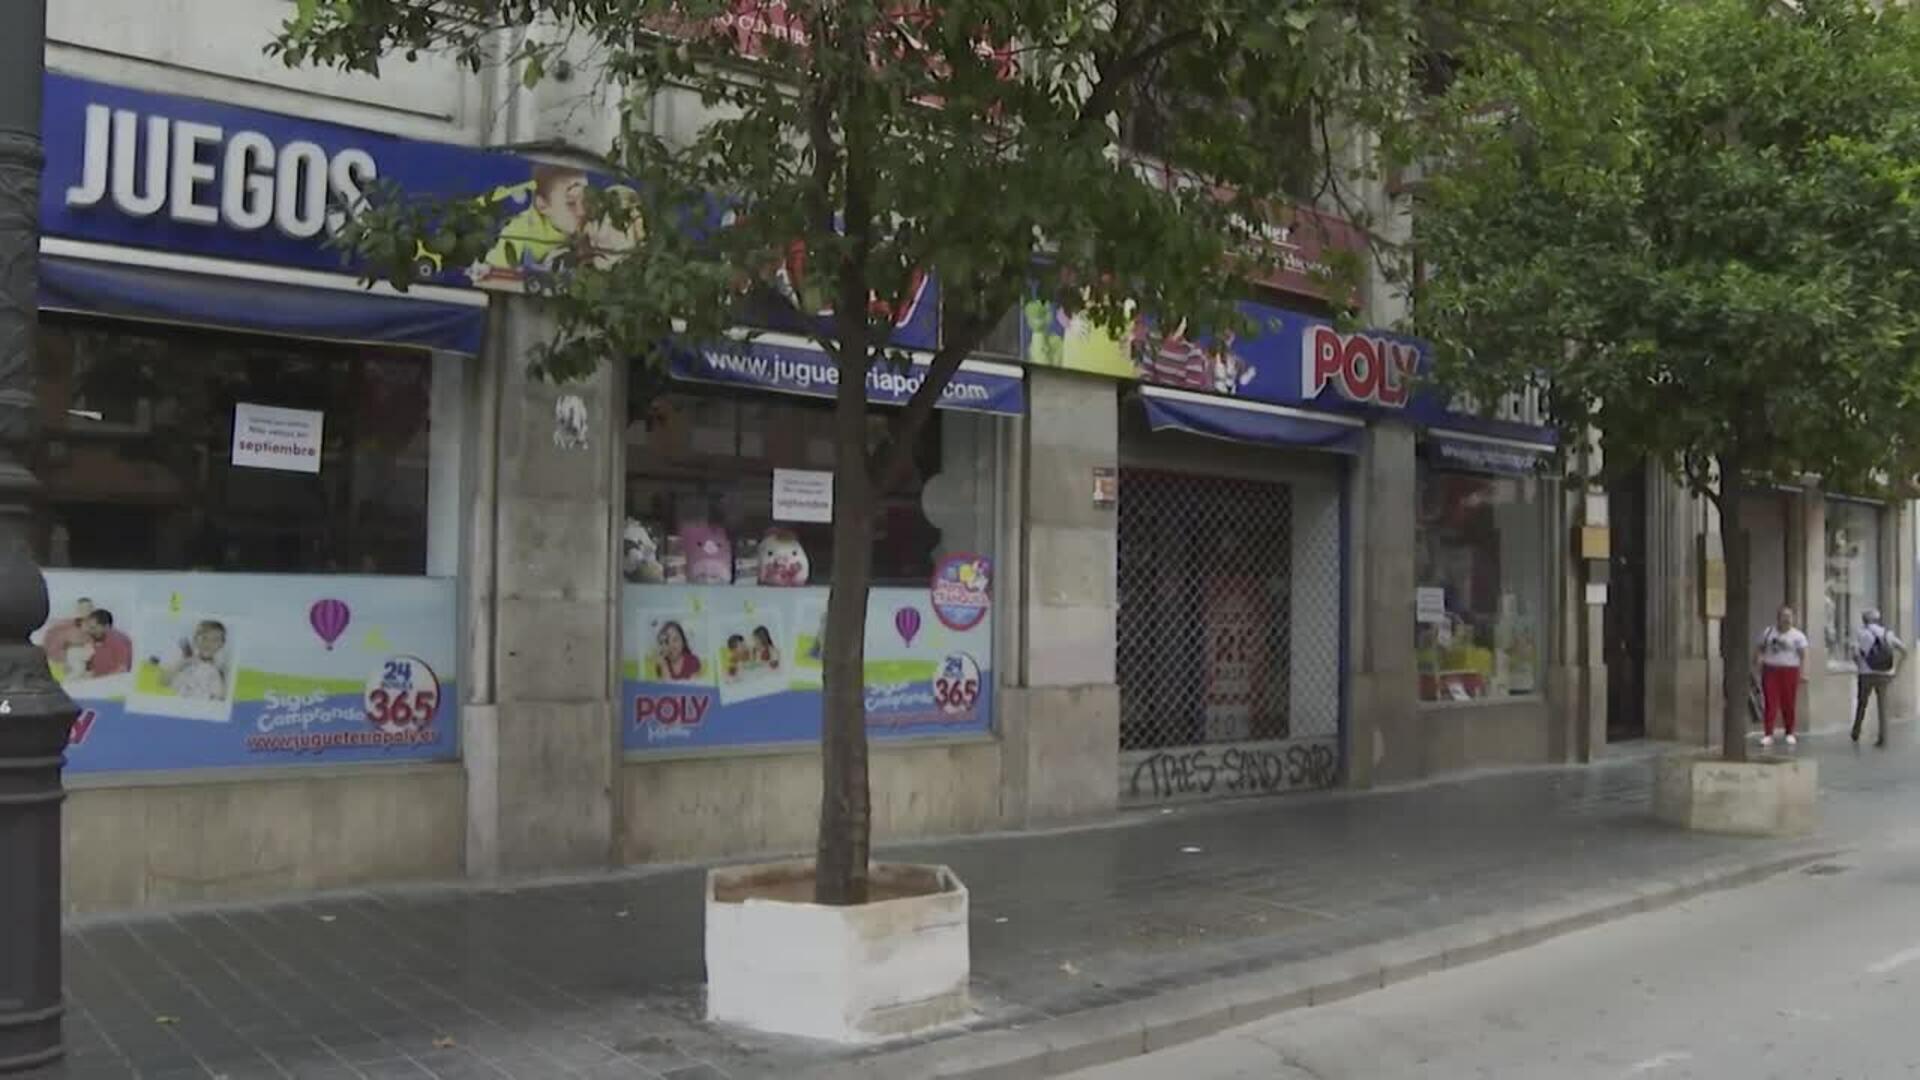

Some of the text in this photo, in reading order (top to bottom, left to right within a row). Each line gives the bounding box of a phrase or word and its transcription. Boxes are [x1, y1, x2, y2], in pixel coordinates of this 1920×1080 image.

[66, 103, 377, 241] JUEGOS
[1302, 325, 1420, 408] POLY
[240, 440, 316, 457] septiembre
[384, 662, 411, 682] 24
[368, 689, 435, 726] 365
[935, 679, 978, 707] 365
[634, 694, 710, 725] POLY
